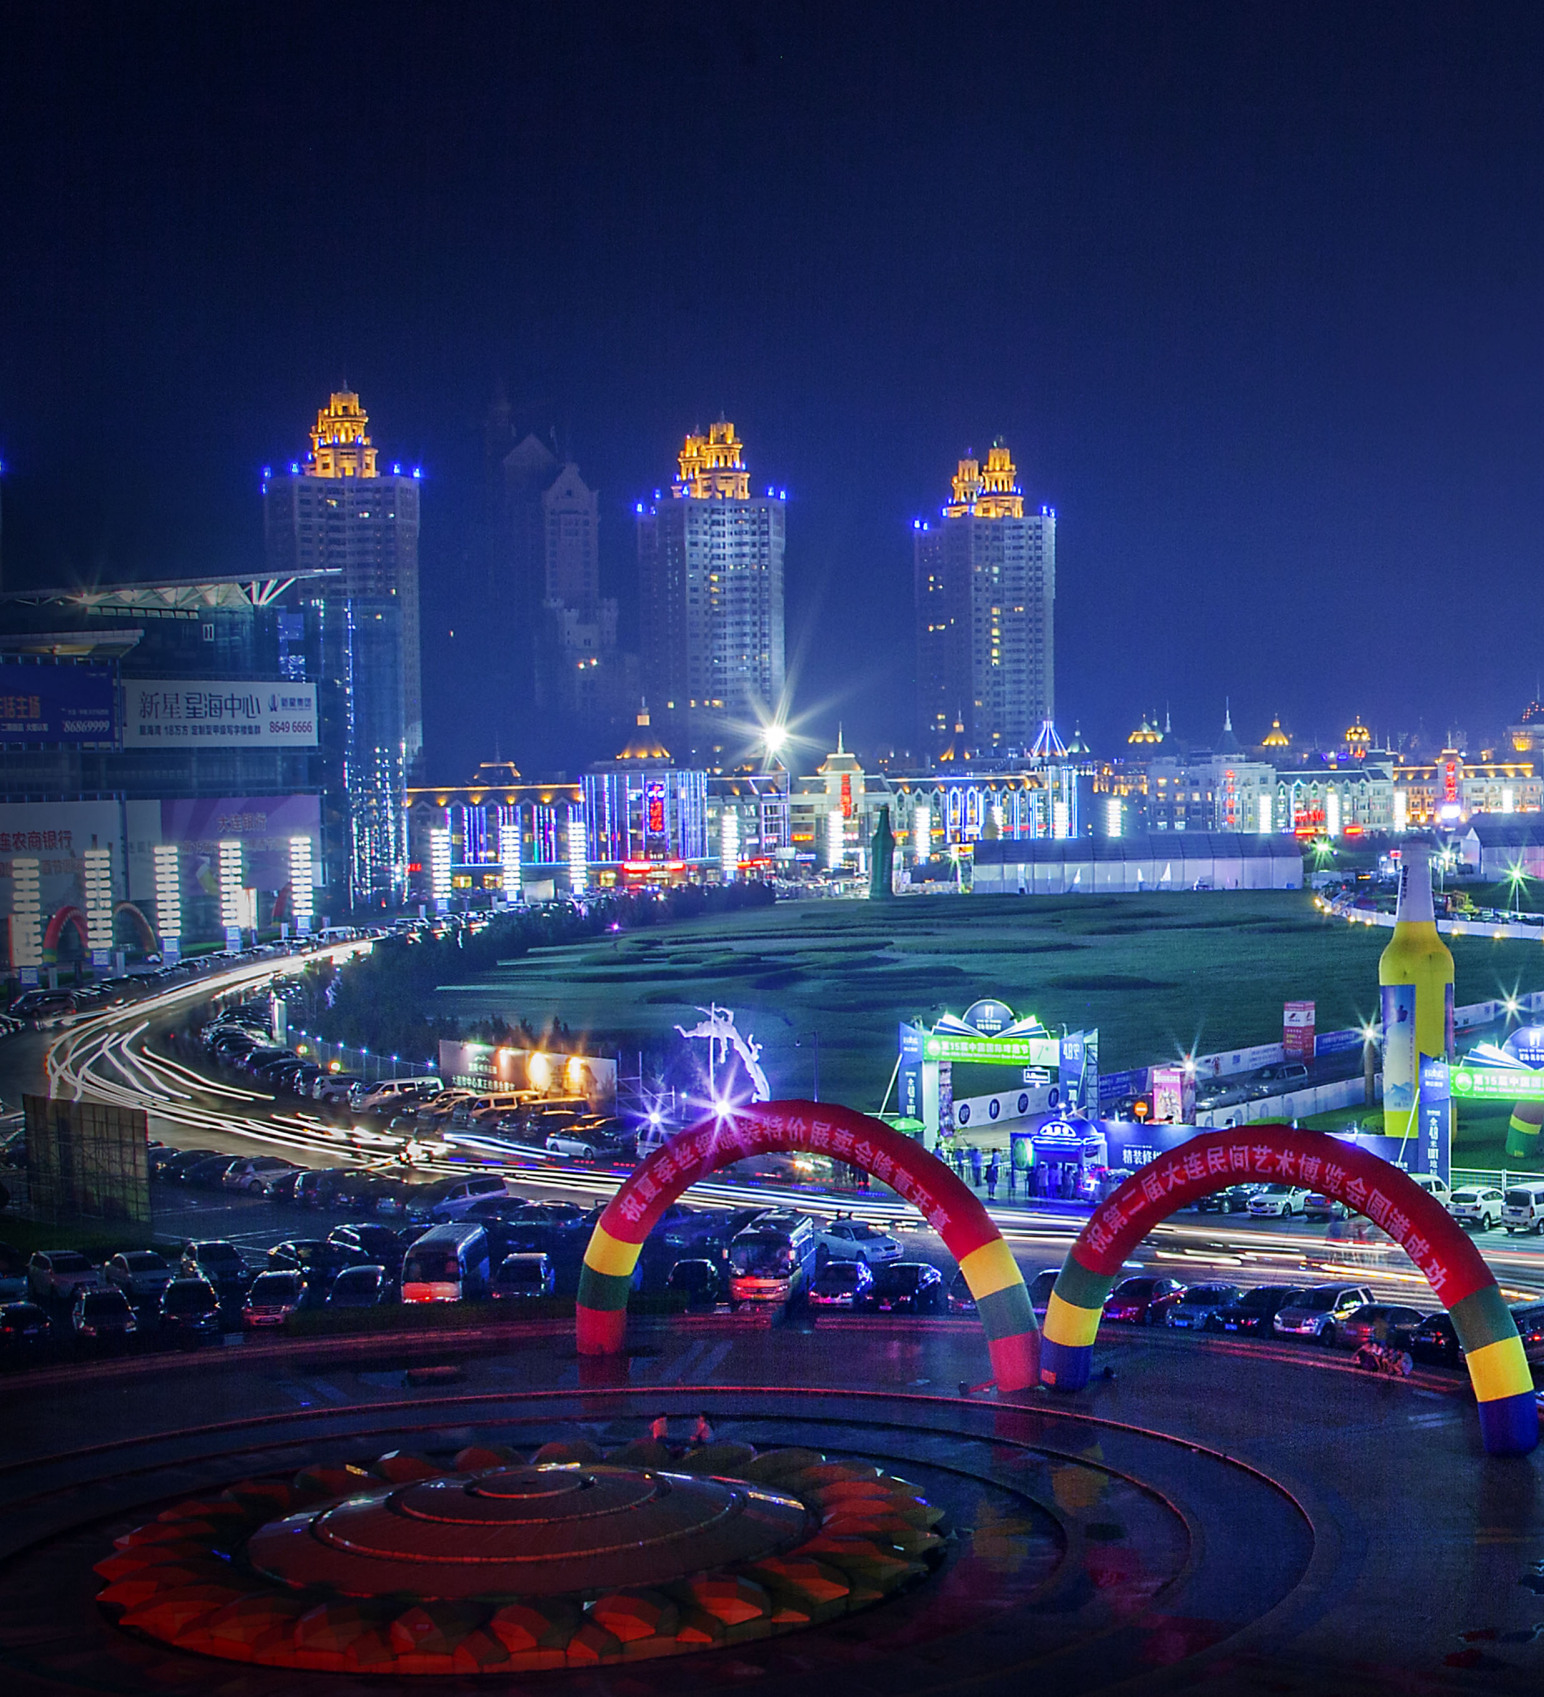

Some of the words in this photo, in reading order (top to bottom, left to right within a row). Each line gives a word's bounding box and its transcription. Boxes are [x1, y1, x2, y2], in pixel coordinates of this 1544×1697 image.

[1085, 1144, 1451, 1291] 祝第二届大连民间艺术博览会圆满成功
